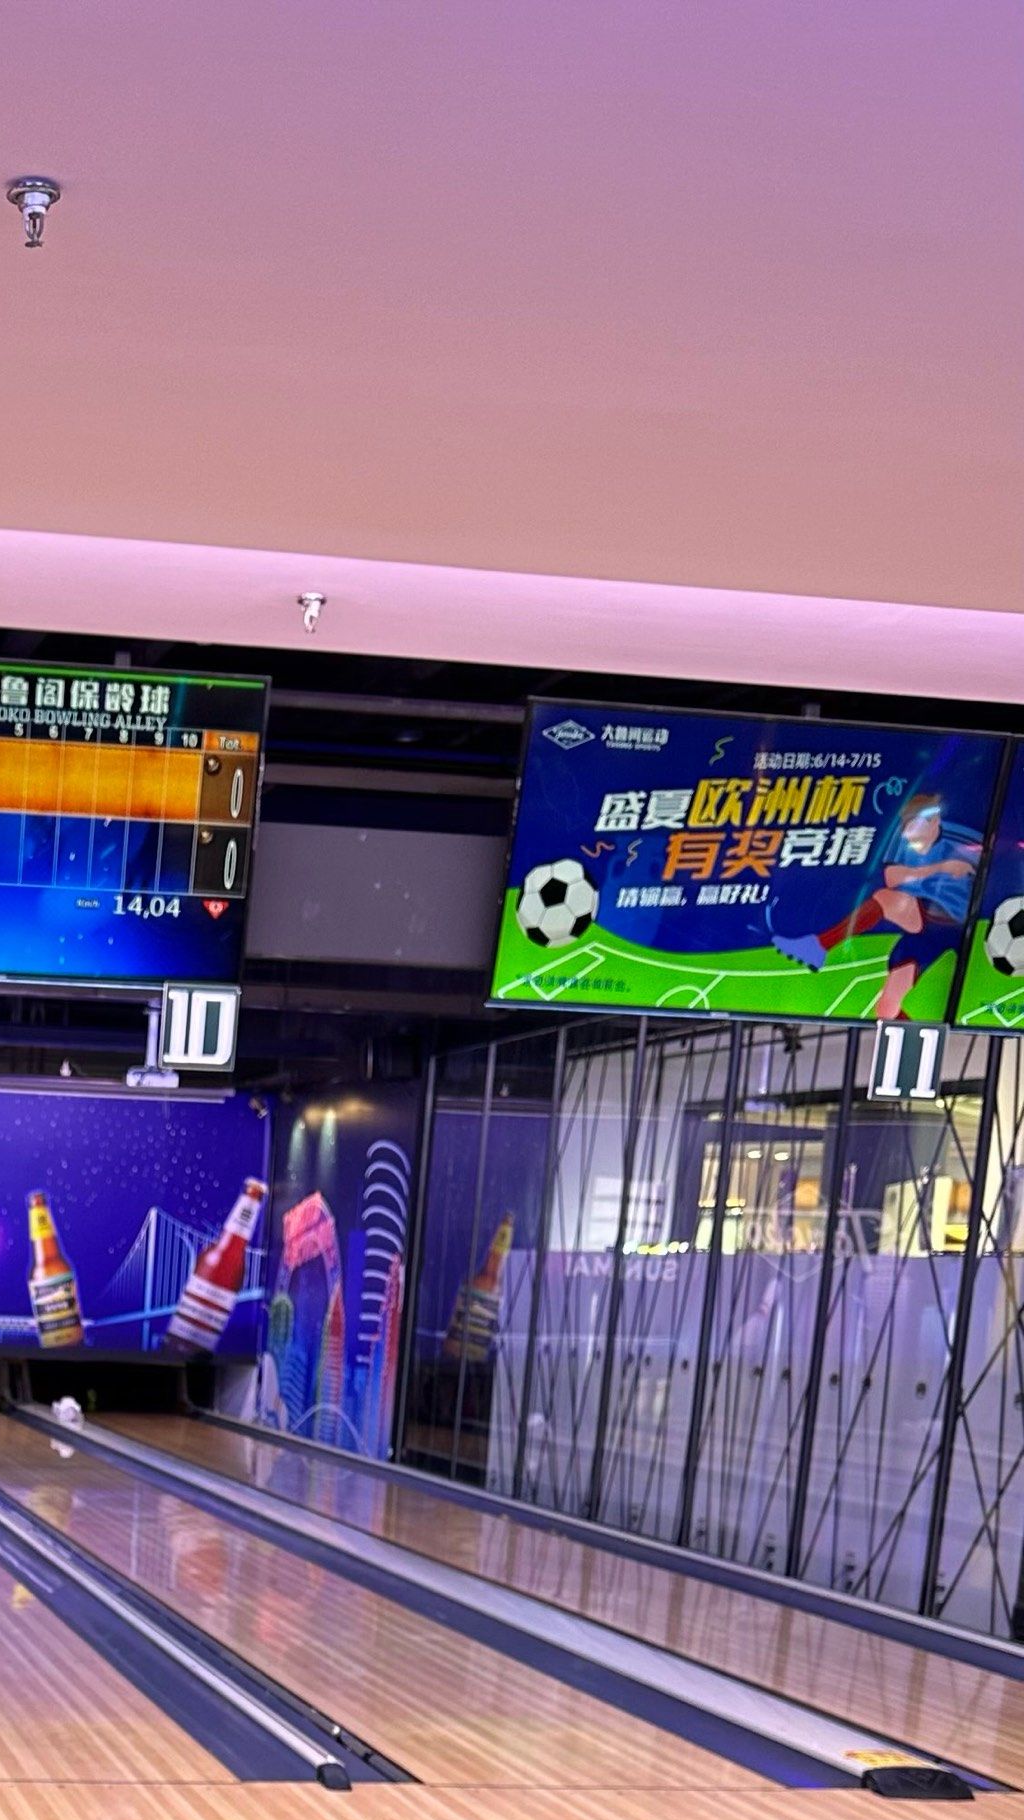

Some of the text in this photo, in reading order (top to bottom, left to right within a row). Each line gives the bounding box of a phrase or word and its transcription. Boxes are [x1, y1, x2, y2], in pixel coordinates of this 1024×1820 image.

[14, 723, 24, 737] 5
[49, 724, 58, 739] 6
[84, 727, 93, 741] 7
[119, 730, 128, 744] 8
[154, 732, 164, 745] 9
[181, 733, 198, 748] 10
[34, 708, 110, 728] BOWLING
[114, 714, 167, 731] ALLEY
[230, 767, 244, 819] 0
[594, 775, 870, 832] 盛夏欧洲杯
[224, 838, 239, 890] 0
[662, 826, 877, 881] 有奖竞猜
[113, 895, 181, 919] 14,04
[163, 988, 236, 1066] 10
[876, 1026, 940, 1098] 11
